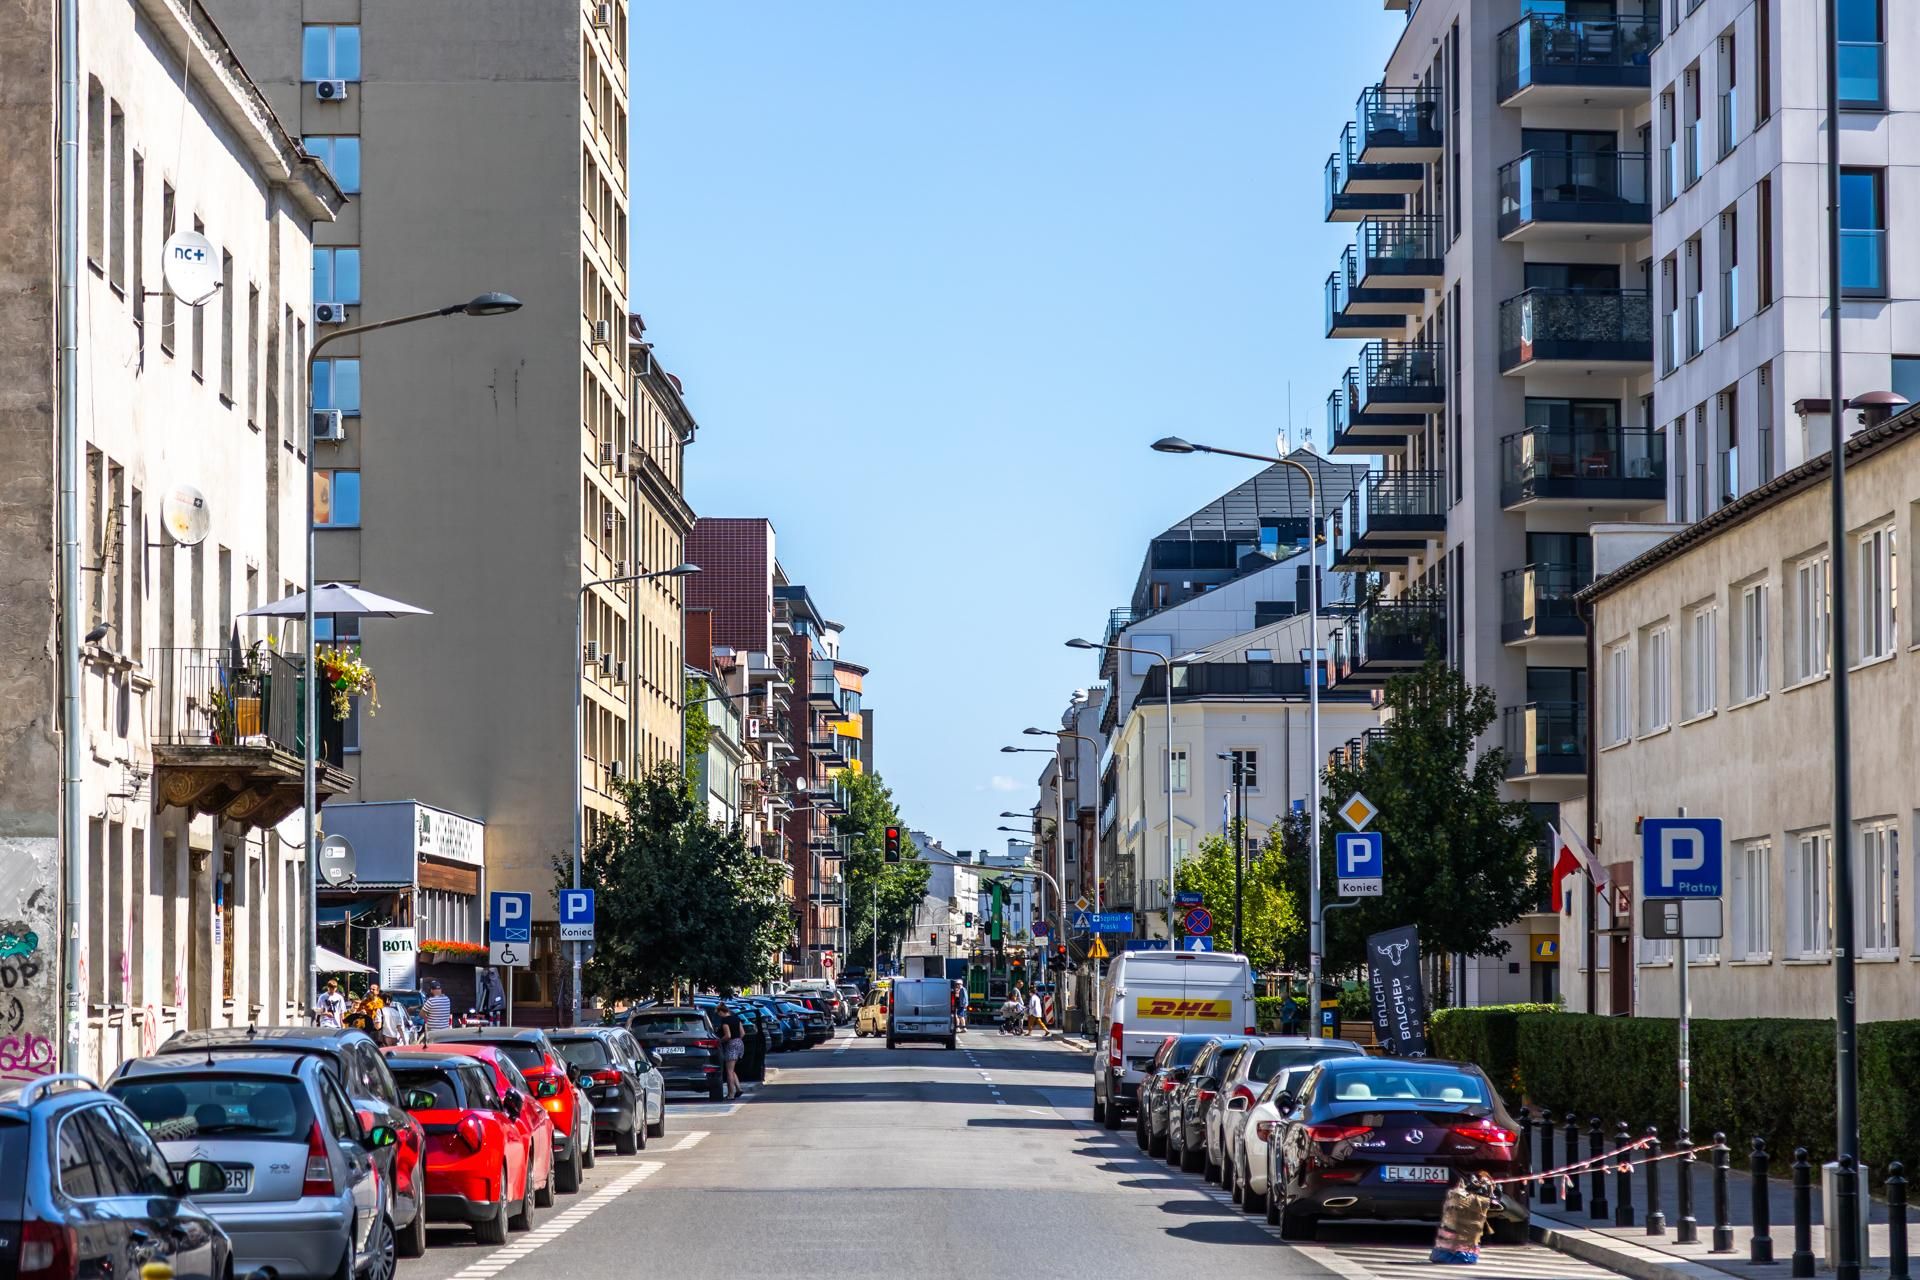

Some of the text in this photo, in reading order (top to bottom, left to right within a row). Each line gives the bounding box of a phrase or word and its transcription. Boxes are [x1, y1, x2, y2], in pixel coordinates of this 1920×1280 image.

[175, 247, 205, 261] nc+
[1346, 838, 1372, 873] P
[1661, 827, 1705, 888] P
[1343, 883, 1378, 893] Koniec
[1679, 881, 1718, 896] Płatny
[499, 896, 523, 928] P
[568, 893, 587, 920] P
[1100, 914, 1121, 922] Szpital
[561, 927, 593, 937] Koniec
[382, 940, 413, 952] BOTA
[1150, 1001, 1219, 1017] DHL
[1323, 1012, 1332, 1023] P
[1388, 1167, 1446, 1180] EL 4JR61
